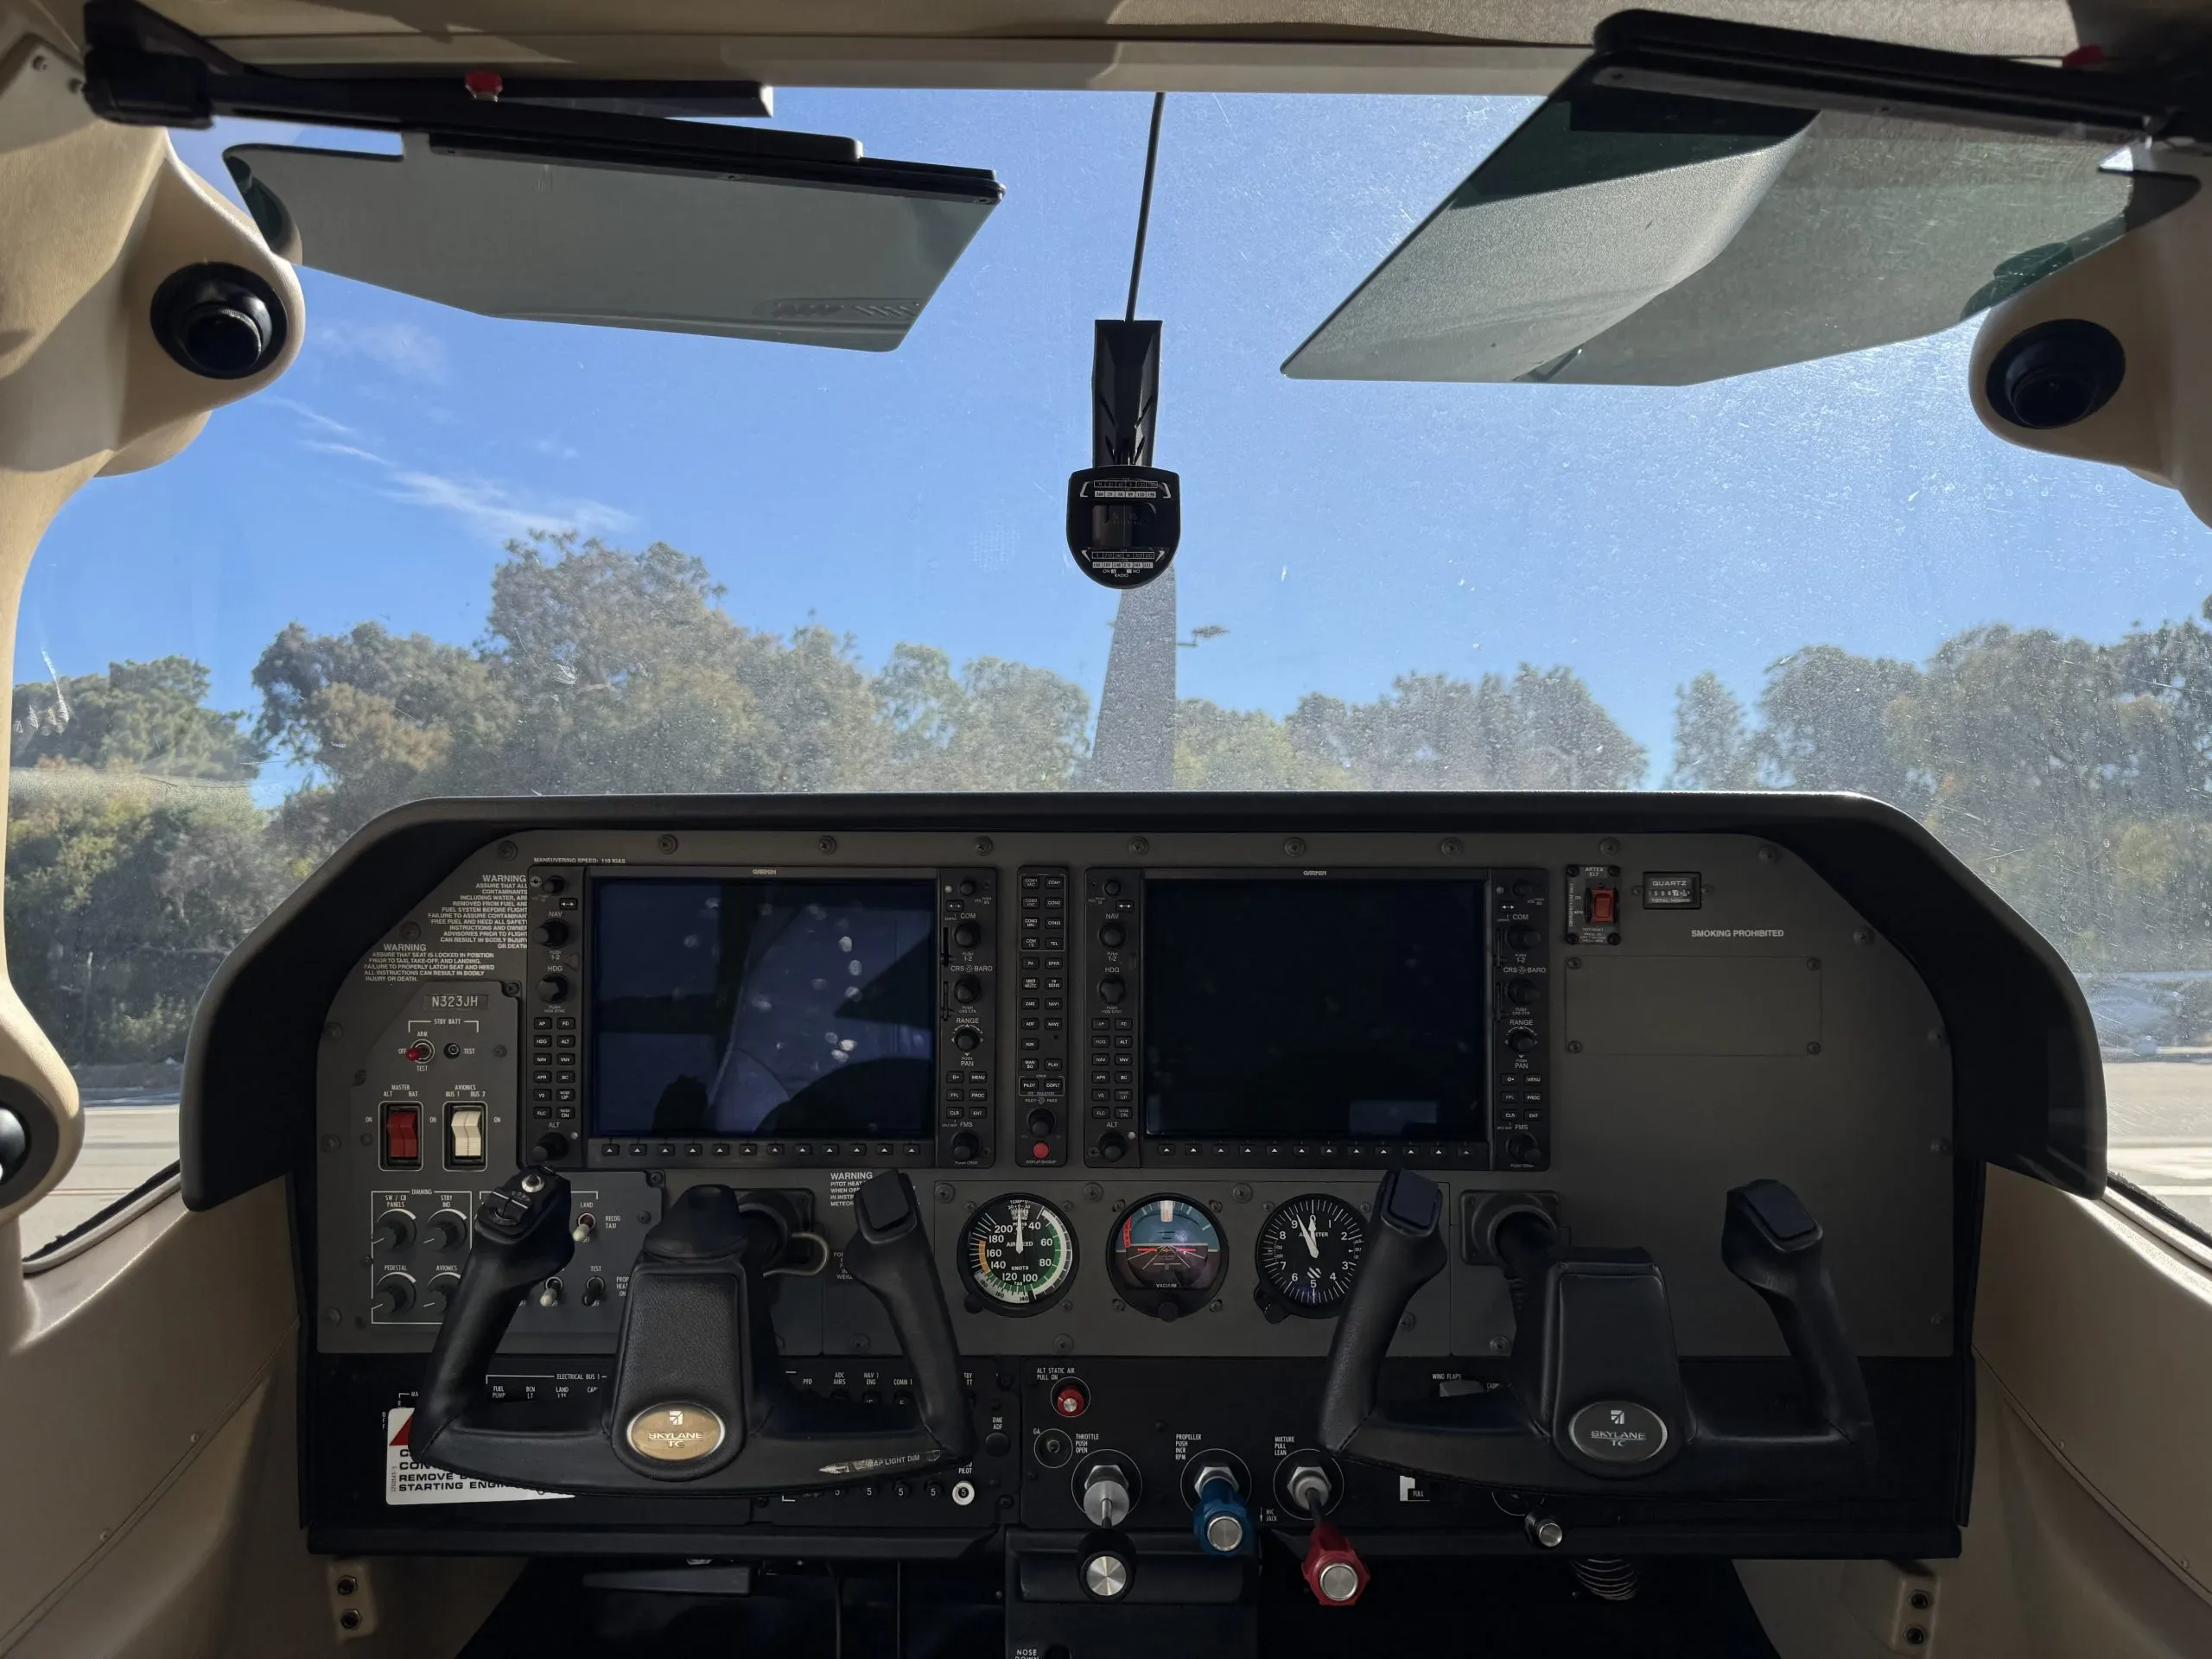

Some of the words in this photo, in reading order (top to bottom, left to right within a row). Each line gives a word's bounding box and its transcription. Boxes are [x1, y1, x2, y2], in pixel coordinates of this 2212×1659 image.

[432, 995, 478, 1007] N323JH
[830, 1172, 873, 1180] WARNING
[1291, 1220, 1298, 1229] 9
[989, 1235, 1004, 1243] 180
[1280, 1231, 1286, 1240] 8
[1341, 1231, 1348, 1240] 2
[987, 1249, 1001, 1257] 160
[991, 1261, 1006, 1269] 140
[1039, 1258, 1052, 1267] 80
[1280, 1262, 1287, 1270] 7
[1342, 1261, 1349, 1270] 3
[1002, 1272, 1018, 1281] 120
[1023, 1274, 1038, 1282] 100
[1291, 1273, 1298, 1281] 6
[1330, 1272, 1337, 1281] 4
[885, 1457, 906, 1465] LIGHT
[399, 1472, 454, 1482] REMOVE
[399, 1482, 463, 1491] STARTING
[867, 1487, 872, 1496] 5
[931, 1488, 936, 1497] 5
